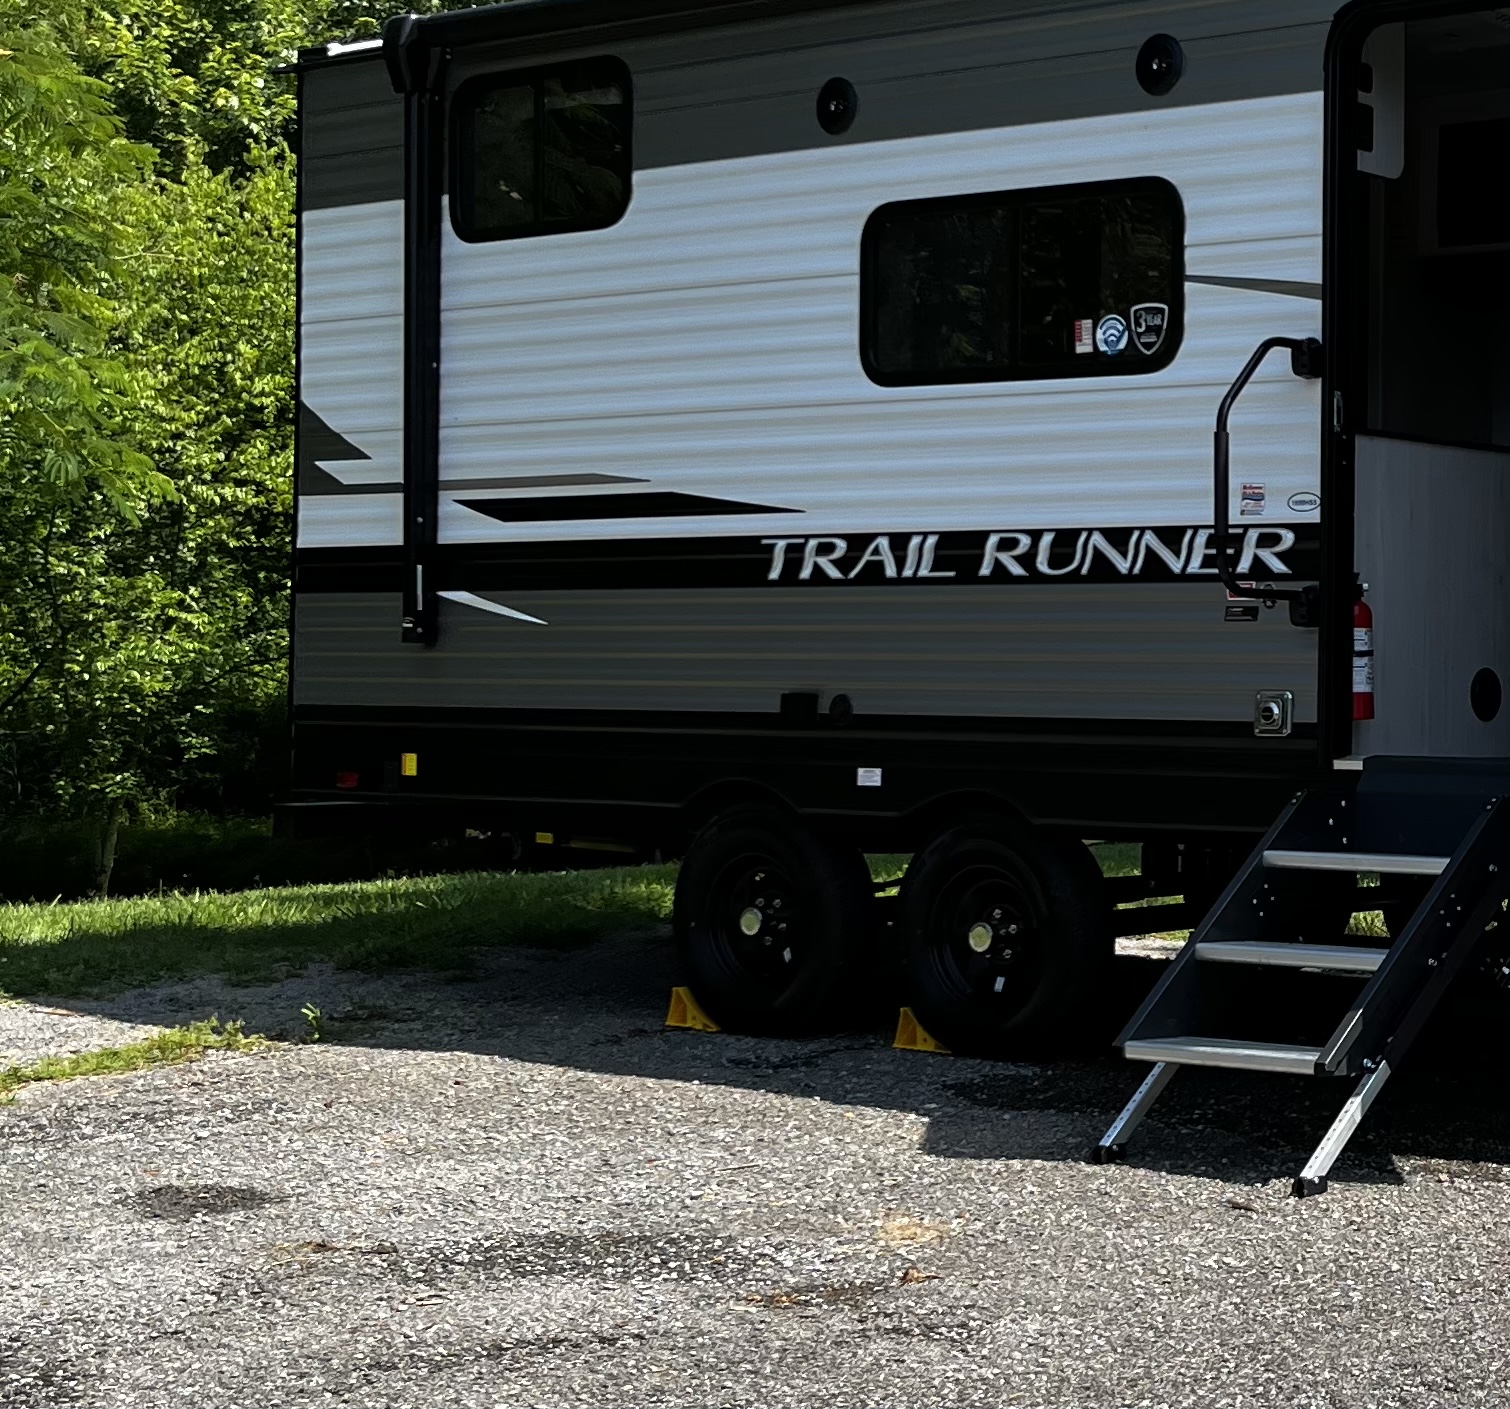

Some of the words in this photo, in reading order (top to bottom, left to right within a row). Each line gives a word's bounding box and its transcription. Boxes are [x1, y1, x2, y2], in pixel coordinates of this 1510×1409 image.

[1136, 310, 1146, 332] 3
[760, 533, 956, 580] TRAIL
[977, 527, 1295, 577] RUNNER
